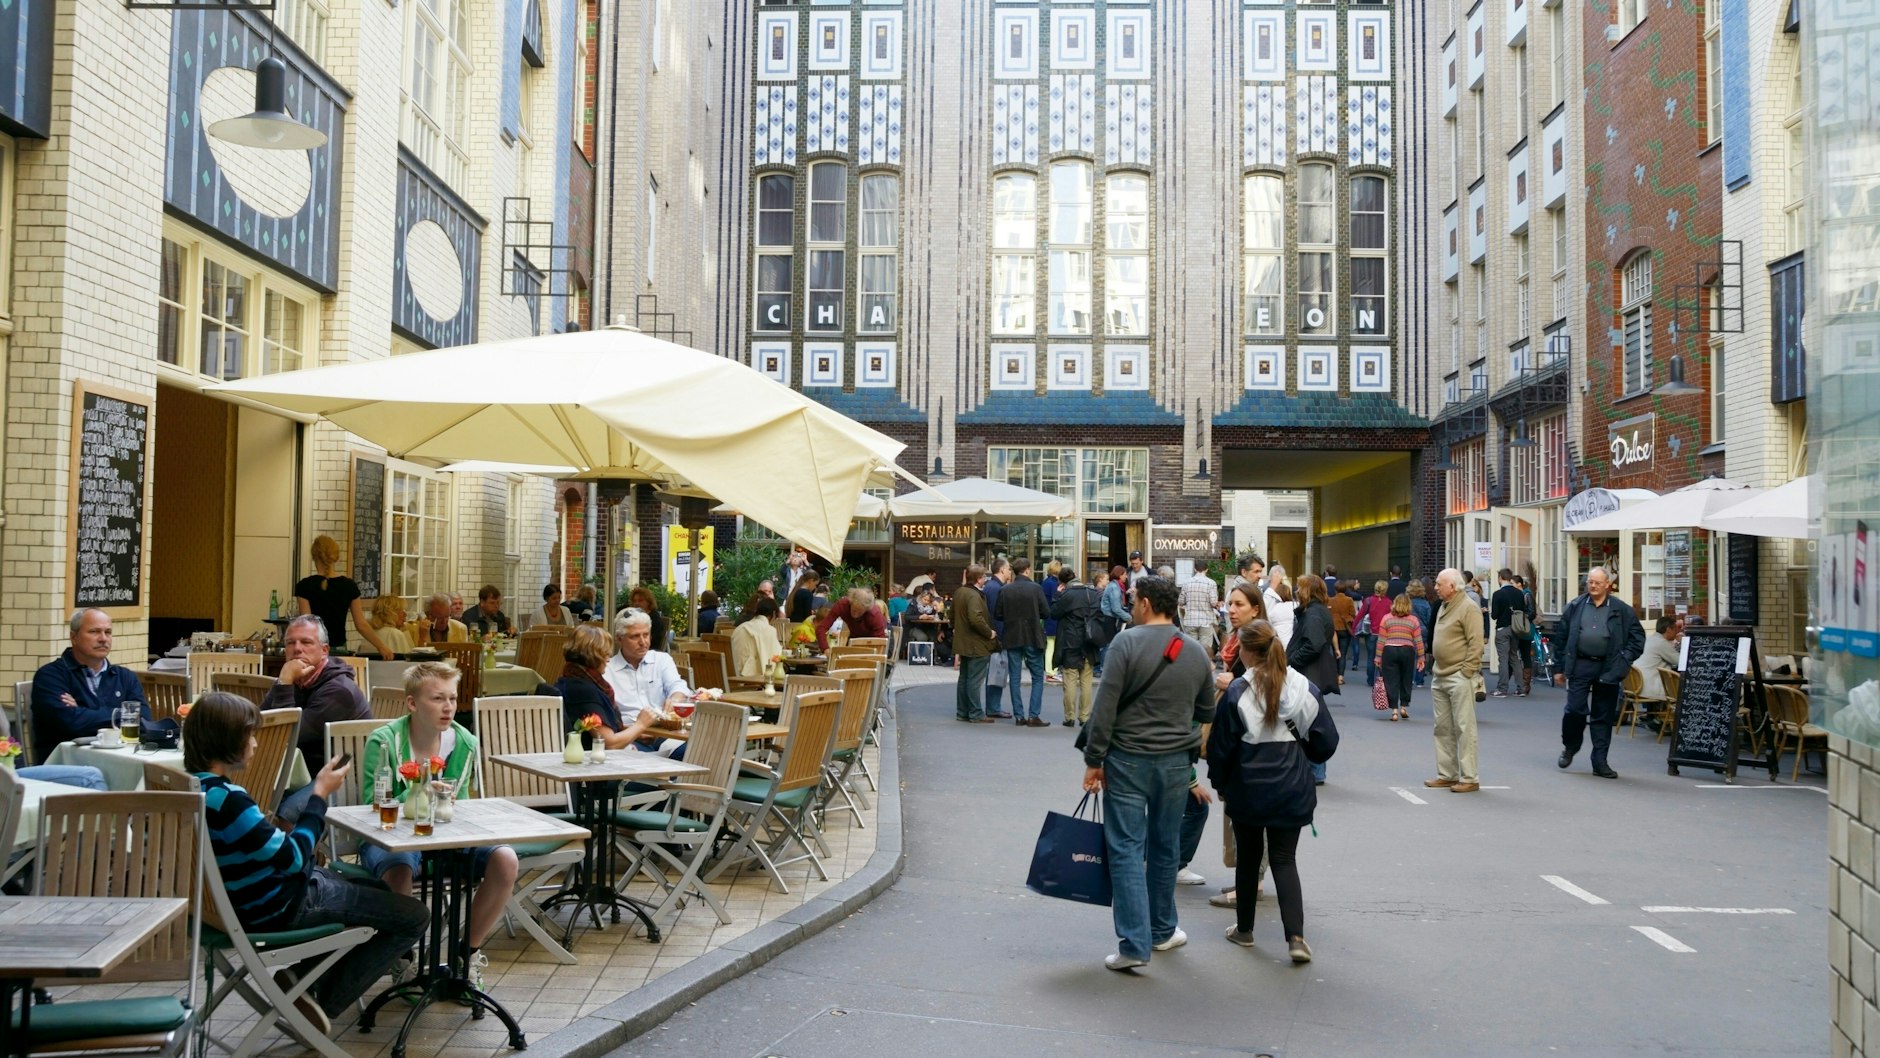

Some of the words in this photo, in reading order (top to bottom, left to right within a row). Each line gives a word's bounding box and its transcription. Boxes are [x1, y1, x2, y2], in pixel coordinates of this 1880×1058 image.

[1610, 430, 1653, 470] Dulce
[902, 524, 977, 539] RESTAURAN
[1154, 538, 1208, 551] OXYMORON
[928, 546, 951, 561] BAR
